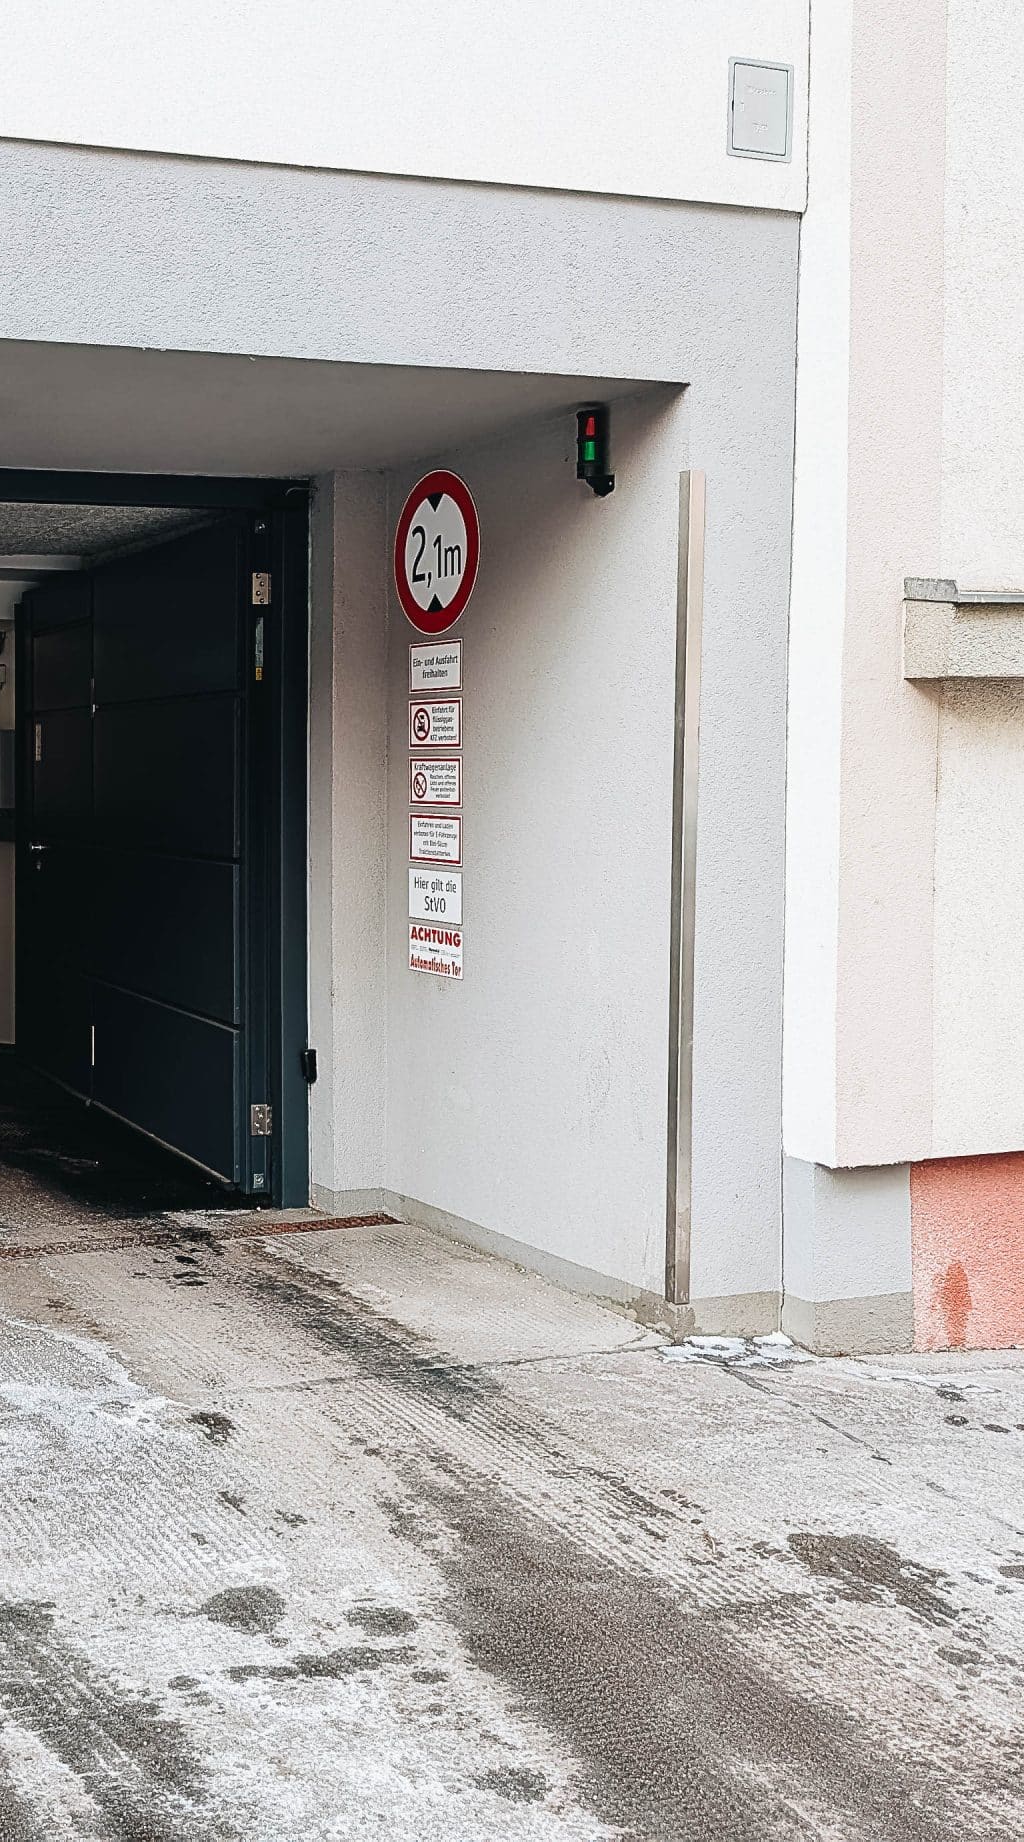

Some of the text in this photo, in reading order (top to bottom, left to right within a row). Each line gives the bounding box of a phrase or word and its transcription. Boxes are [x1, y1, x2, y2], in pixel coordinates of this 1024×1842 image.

[411, 525, 462, 588] 2,1m
[425, 656, 434, 666] und
[435, 655, 458, 665] Ausfahrt
[422, 668, 448, 679] freihalten
[414, 876, 457, 893] Hier gilt die
[424, 895, 446, 914] StVO
[411, 926, 461, 947] ACHTUNG
[411, 953, 450, 974] Automatisches
[452, 961, 461, 976] Tor
